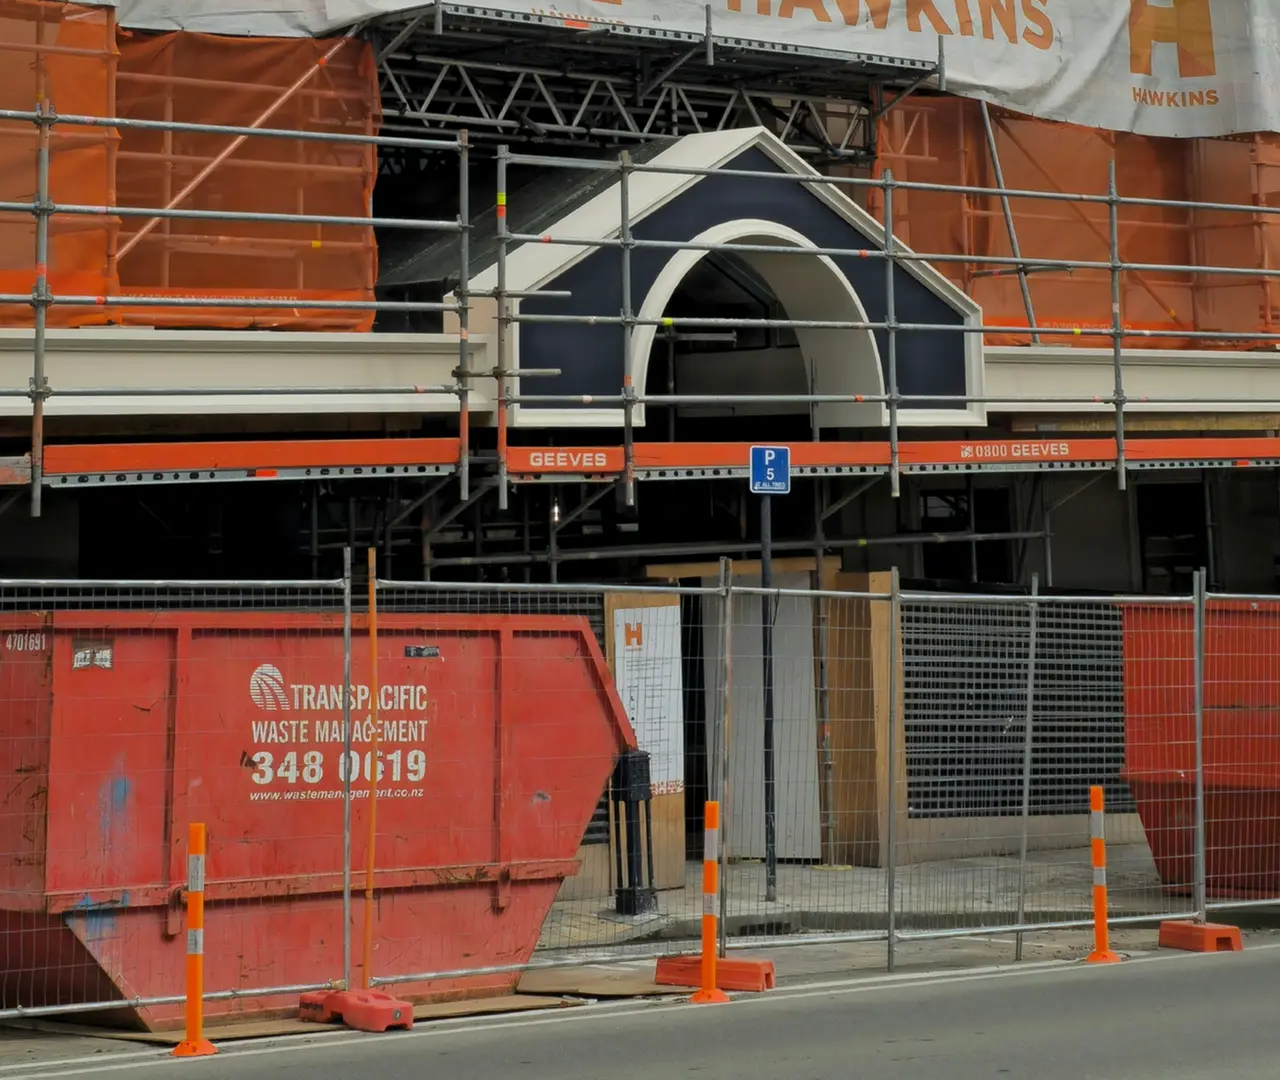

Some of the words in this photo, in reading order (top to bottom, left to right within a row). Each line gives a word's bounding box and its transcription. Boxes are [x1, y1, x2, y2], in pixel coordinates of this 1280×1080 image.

[1131, 85, 1220, 108] HAWKINS
[765, 450, 776, 466] P
[975, 444, 1008, 458] 0800
[1011, 443, 1070, 457] GEEVES
[529, 452, 607, 467] GEEVES
[766, 468, 775, 481] 5
[251, 720, 309, 744] WASTE
[251, 751, 324, 785] 348
[338, 749, 427, 783] 0619
